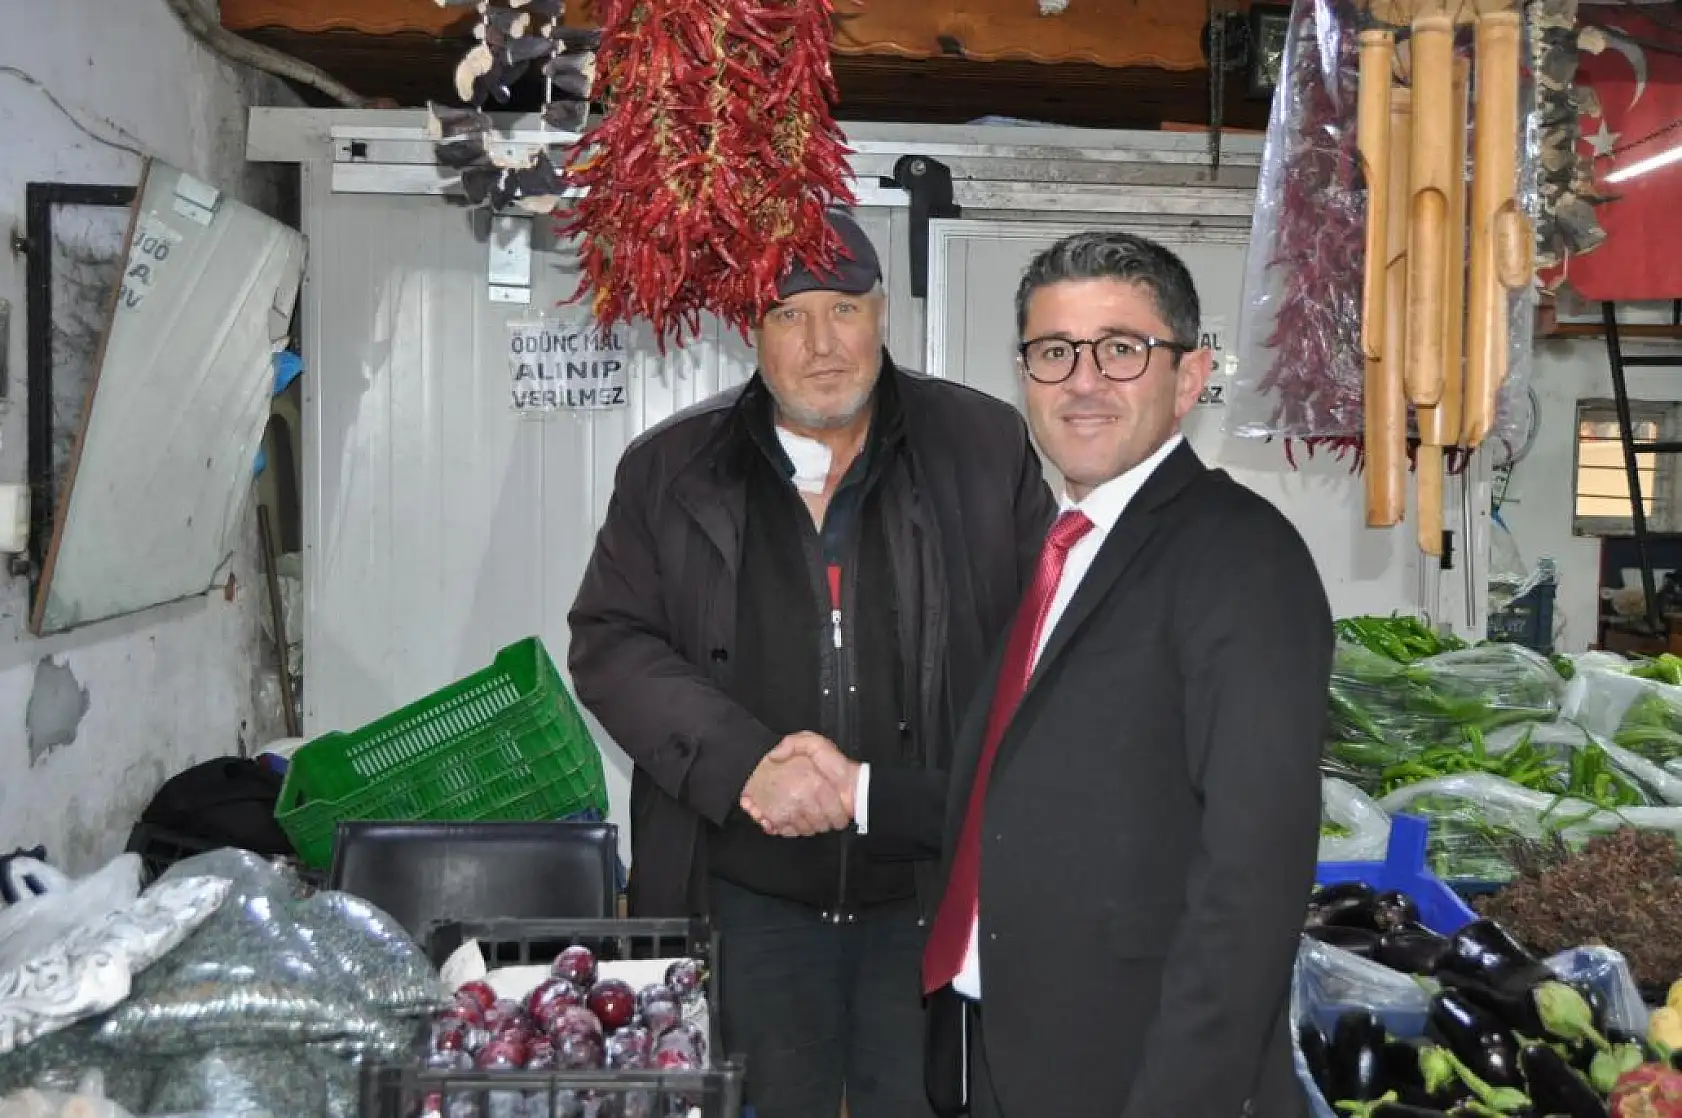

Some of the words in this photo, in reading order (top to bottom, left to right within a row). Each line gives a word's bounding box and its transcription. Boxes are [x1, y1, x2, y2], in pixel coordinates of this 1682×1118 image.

[511, 330, 578, 356] ÖDÜNÇ
[584, 333, 623, 352] MAL
[1200, 332, 1223, 351] AL
[514, 360, 622, 380] ALINIP
